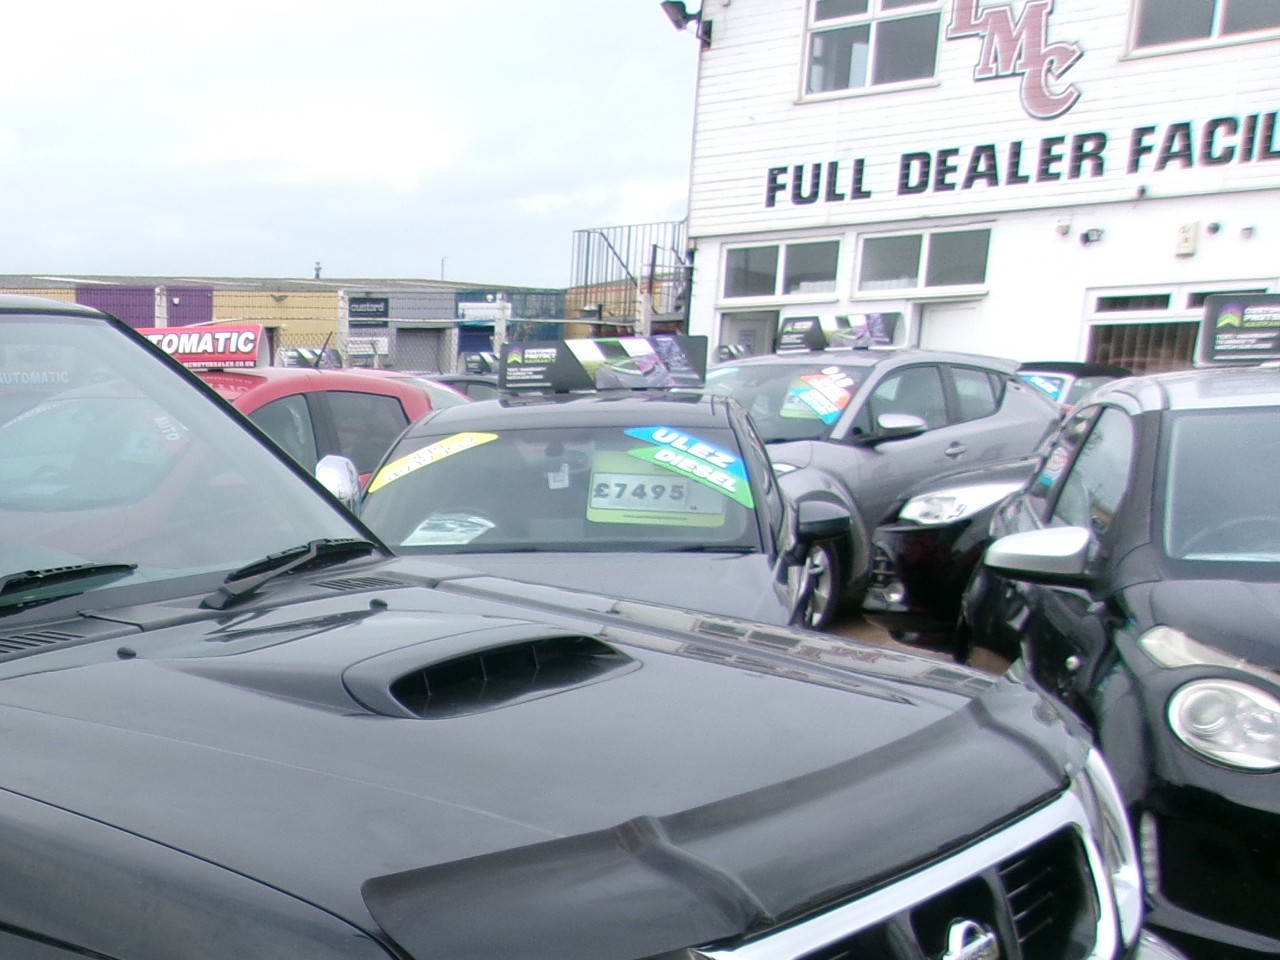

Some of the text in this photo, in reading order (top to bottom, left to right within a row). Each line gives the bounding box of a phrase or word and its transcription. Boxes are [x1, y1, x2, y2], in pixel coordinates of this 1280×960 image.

[765, 158, 873, 208] FULL
[896, 131, 1109, 197] DEALER
[145, 331, 256, 354] TOMATIC
[651, 427, 736, 469] ULEZ
[593, 482, 685, 500] £7495
[653, 449, 737, 492] DIESEL
